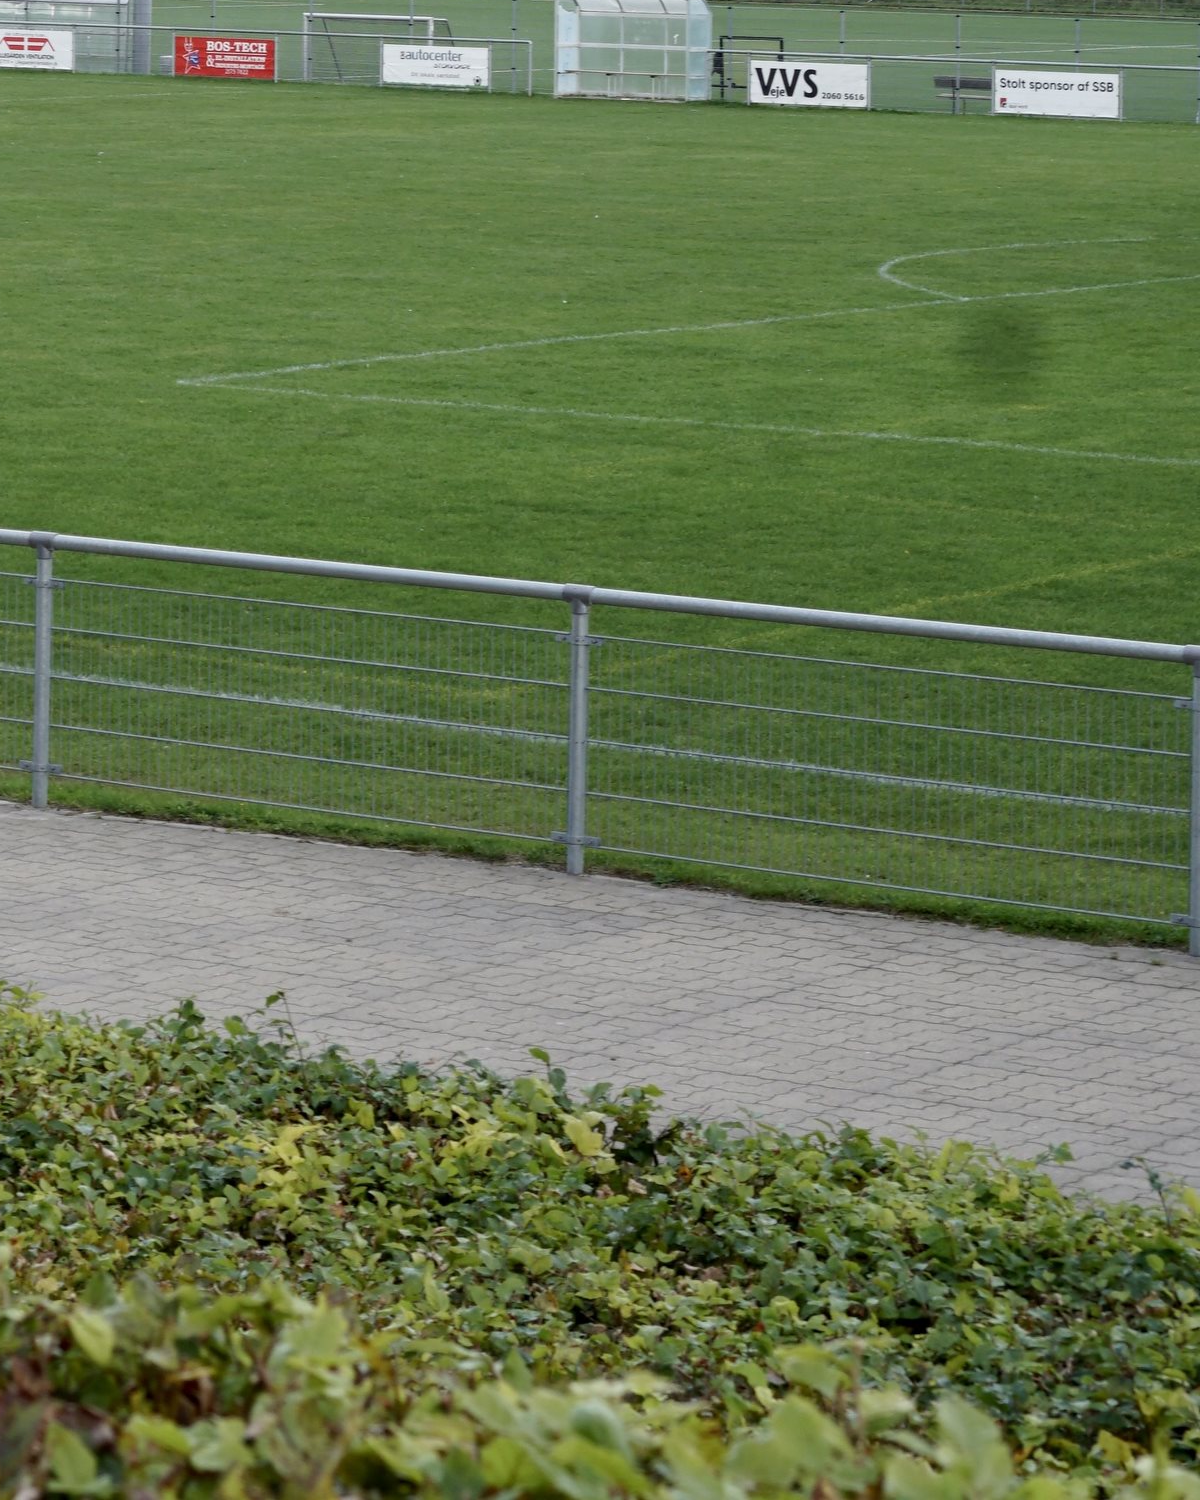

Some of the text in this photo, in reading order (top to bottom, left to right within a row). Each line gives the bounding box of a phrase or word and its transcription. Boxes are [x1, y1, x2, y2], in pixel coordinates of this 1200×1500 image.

[206, 40, 268, 53] BOS-TECH
[405, 49, 464, 61] autocenter
[1000, 78, 1114, 93] Stolt sponsor af SSB
[821, 92, 841, 100] 2060
